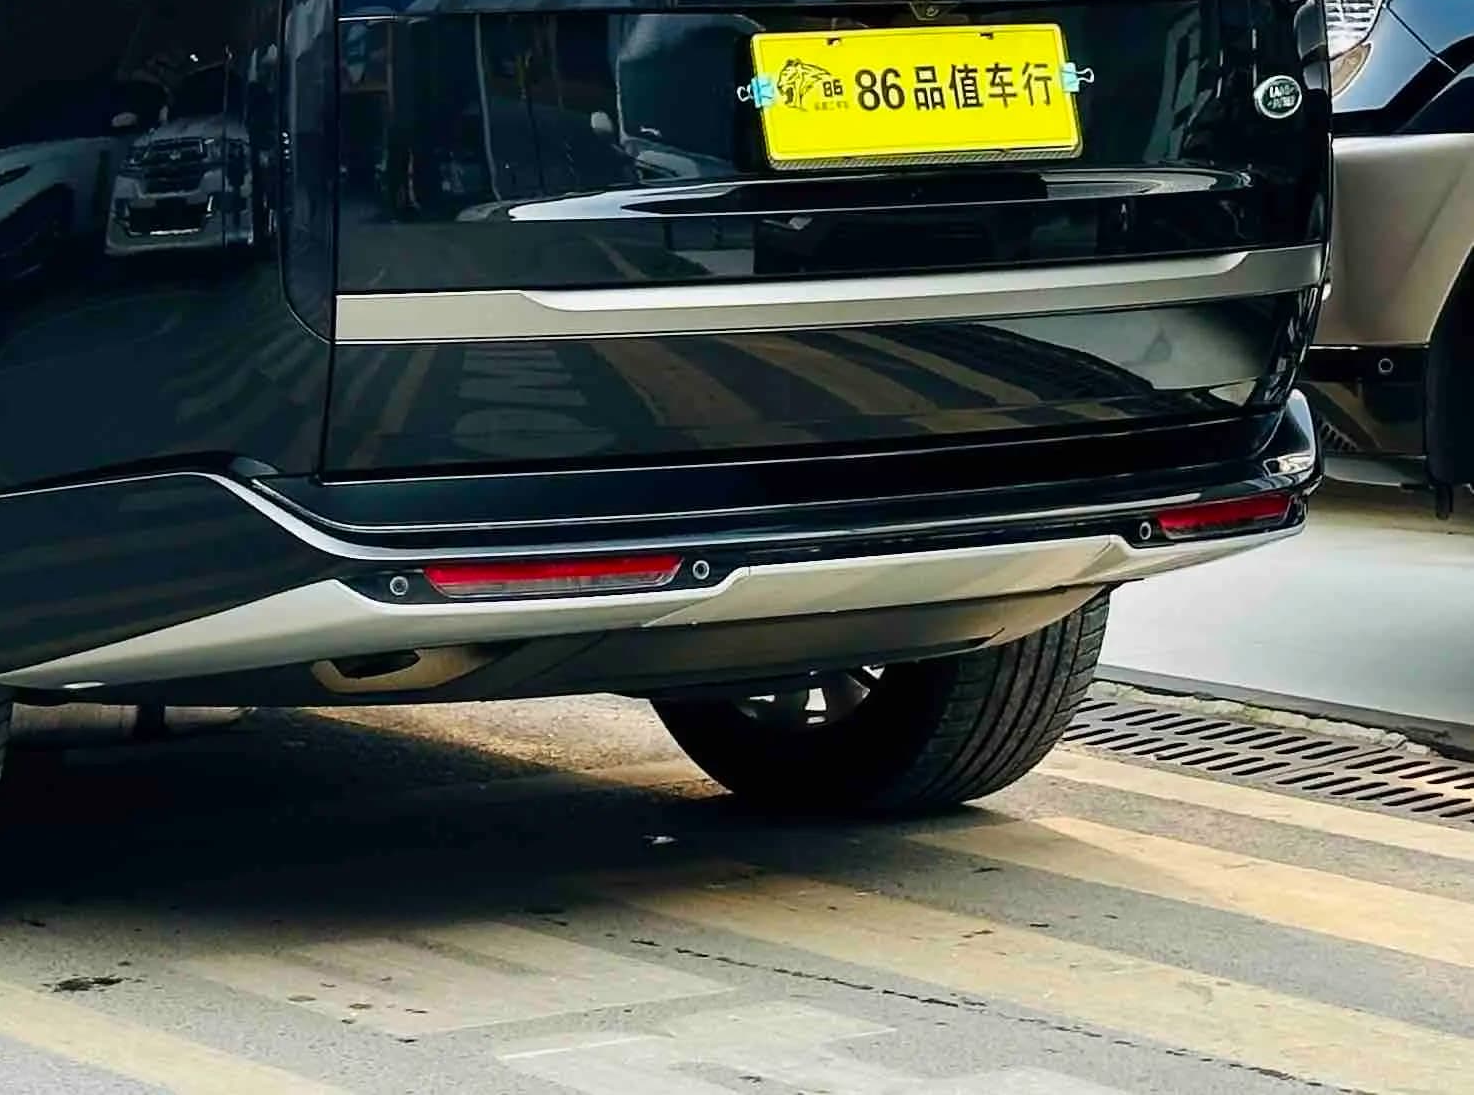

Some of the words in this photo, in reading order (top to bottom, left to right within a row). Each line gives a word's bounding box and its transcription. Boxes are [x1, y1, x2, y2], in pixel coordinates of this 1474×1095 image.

[822, 79, 843, 97] 86
[854, 62, 1052, 111] 86品值车行
